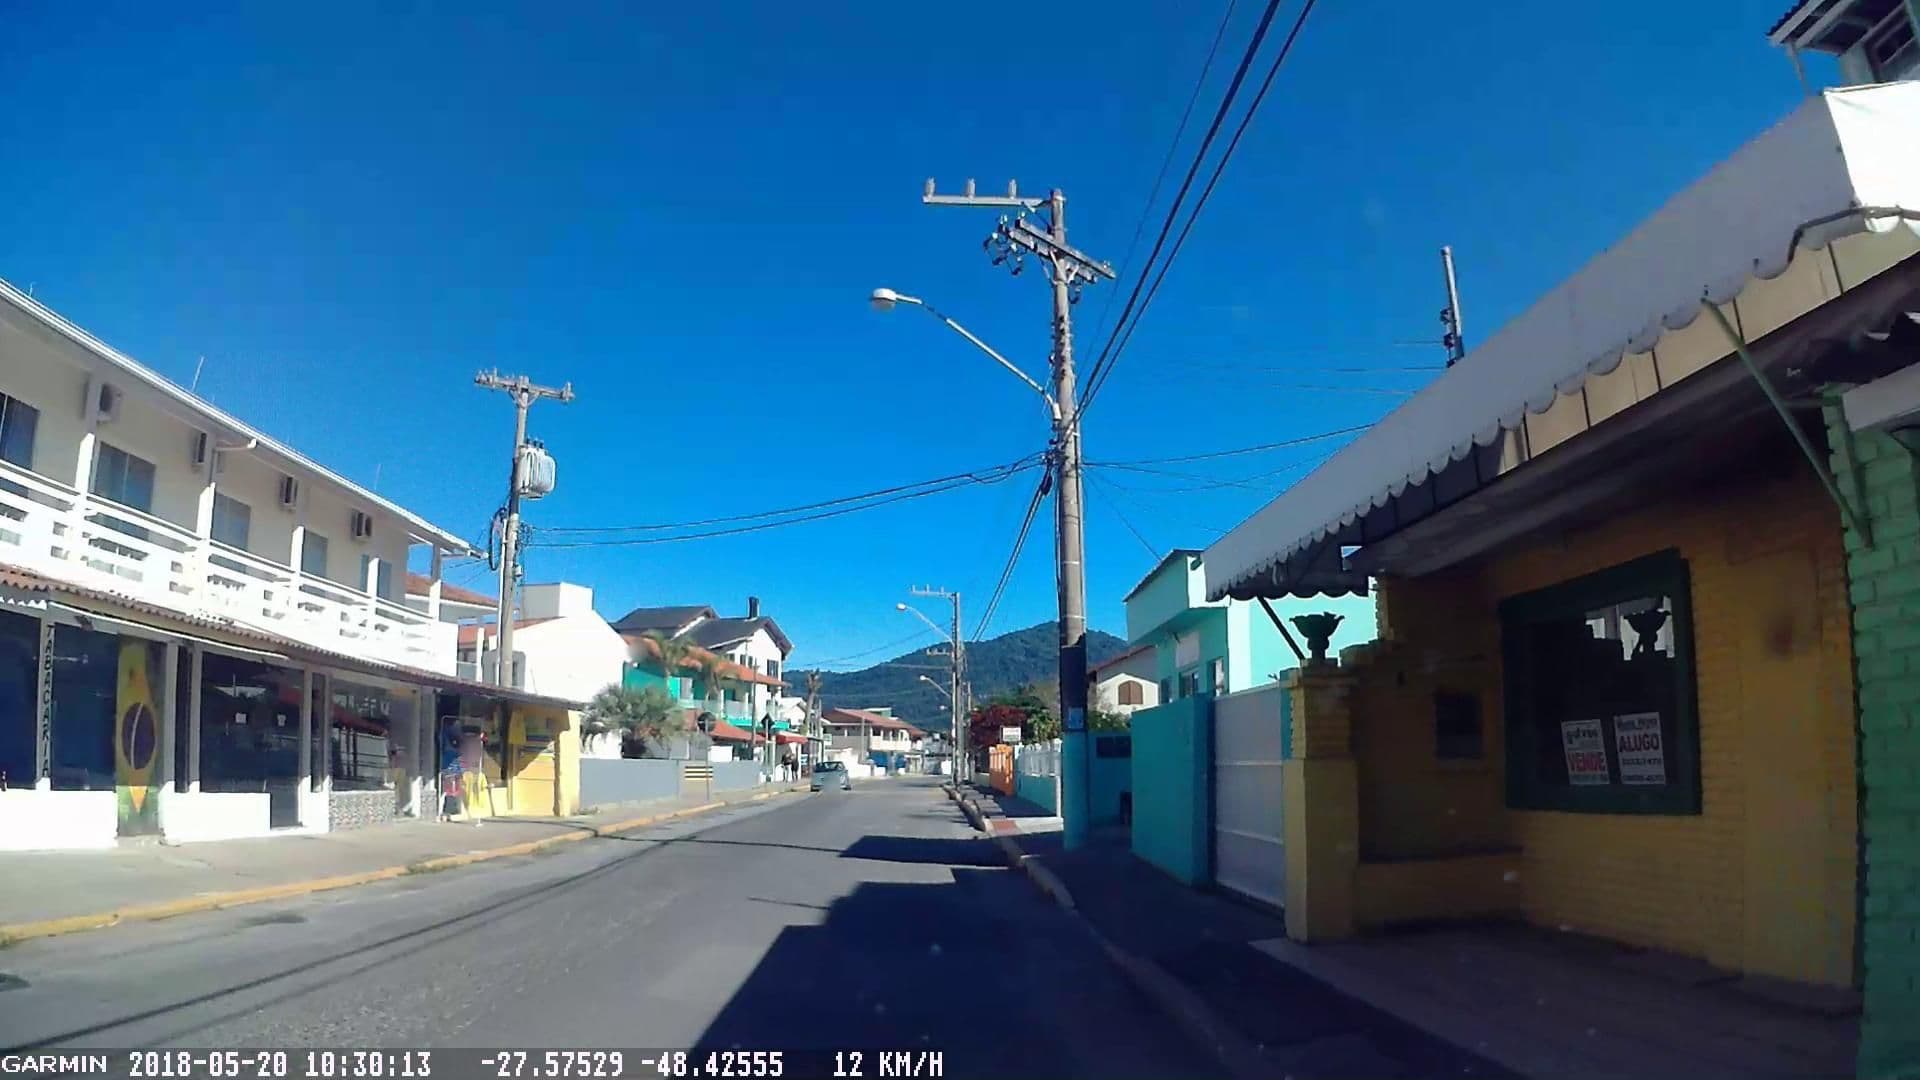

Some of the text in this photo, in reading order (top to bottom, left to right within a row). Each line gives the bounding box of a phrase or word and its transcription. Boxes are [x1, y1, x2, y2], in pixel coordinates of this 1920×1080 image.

[42, 625, 55, 778] TABACARIA
[1619, 733, 1660, 752] ALUGO
[1567, 751, 1606, 772] VENDE
